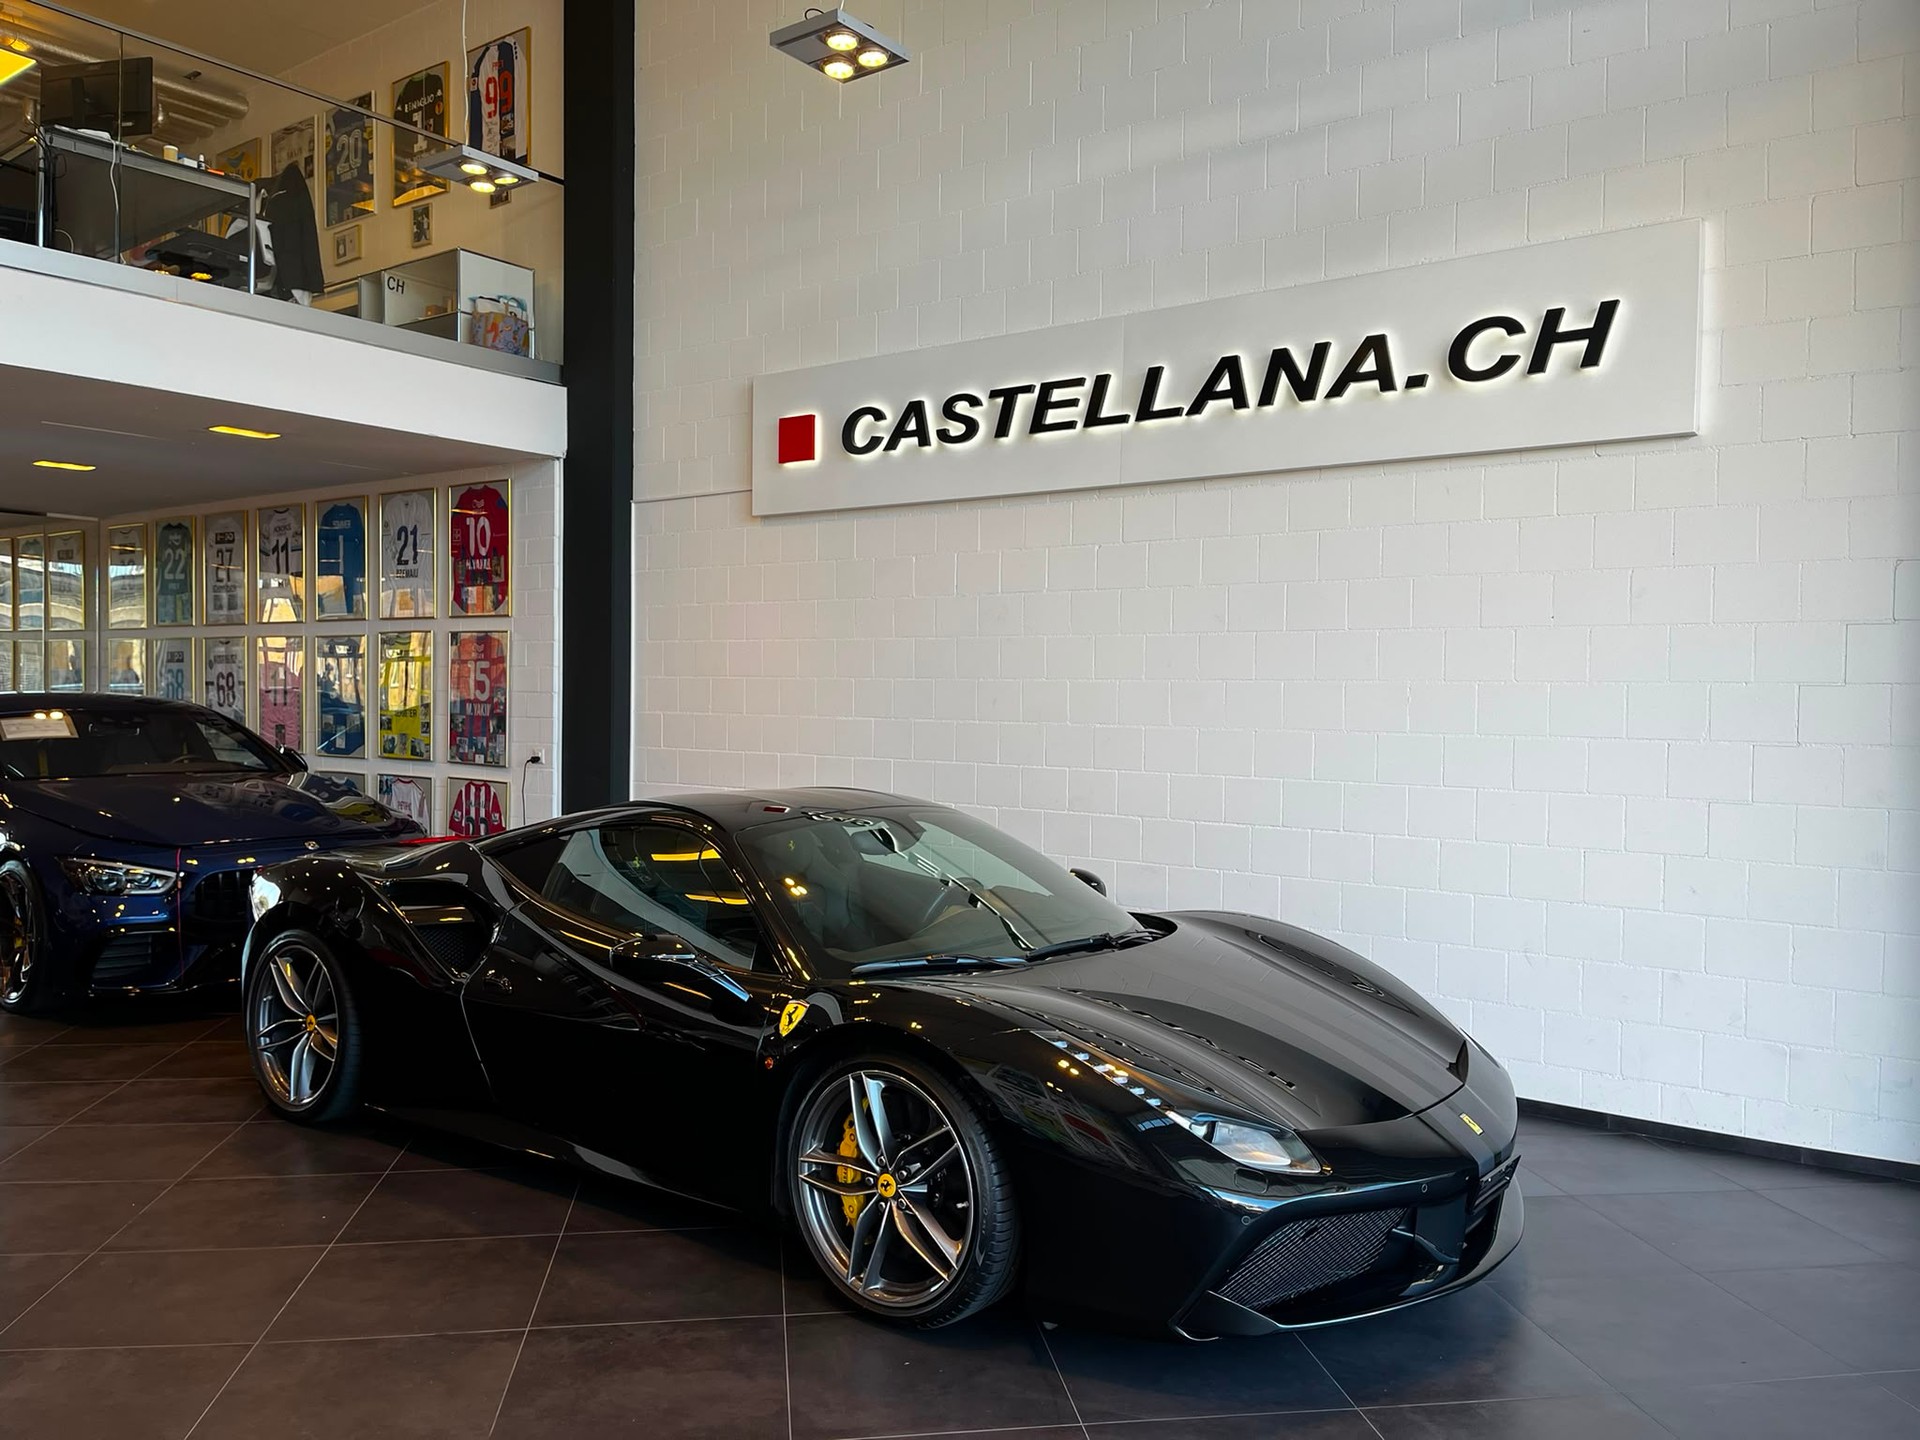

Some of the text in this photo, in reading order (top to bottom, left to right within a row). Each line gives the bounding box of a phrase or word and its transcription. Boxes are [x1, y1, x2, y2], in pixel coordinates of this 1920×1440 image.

[485, 71, 512, 119] 99
[336, 129, 362, 174] 20
[387, 276, 405, 295] CH
[841, 299, 1620, 455] CASTELLANA.CH
[271, 537, 290, 575] 11
[396, 524, 418, 566] 21
[466, 516, 491, 557] 10
[164, 548, 186, 580] 22
[216, 547, 233, 582] 27
[216, 671, 236, 707] 68
[467, 660, 491, 701] 15
